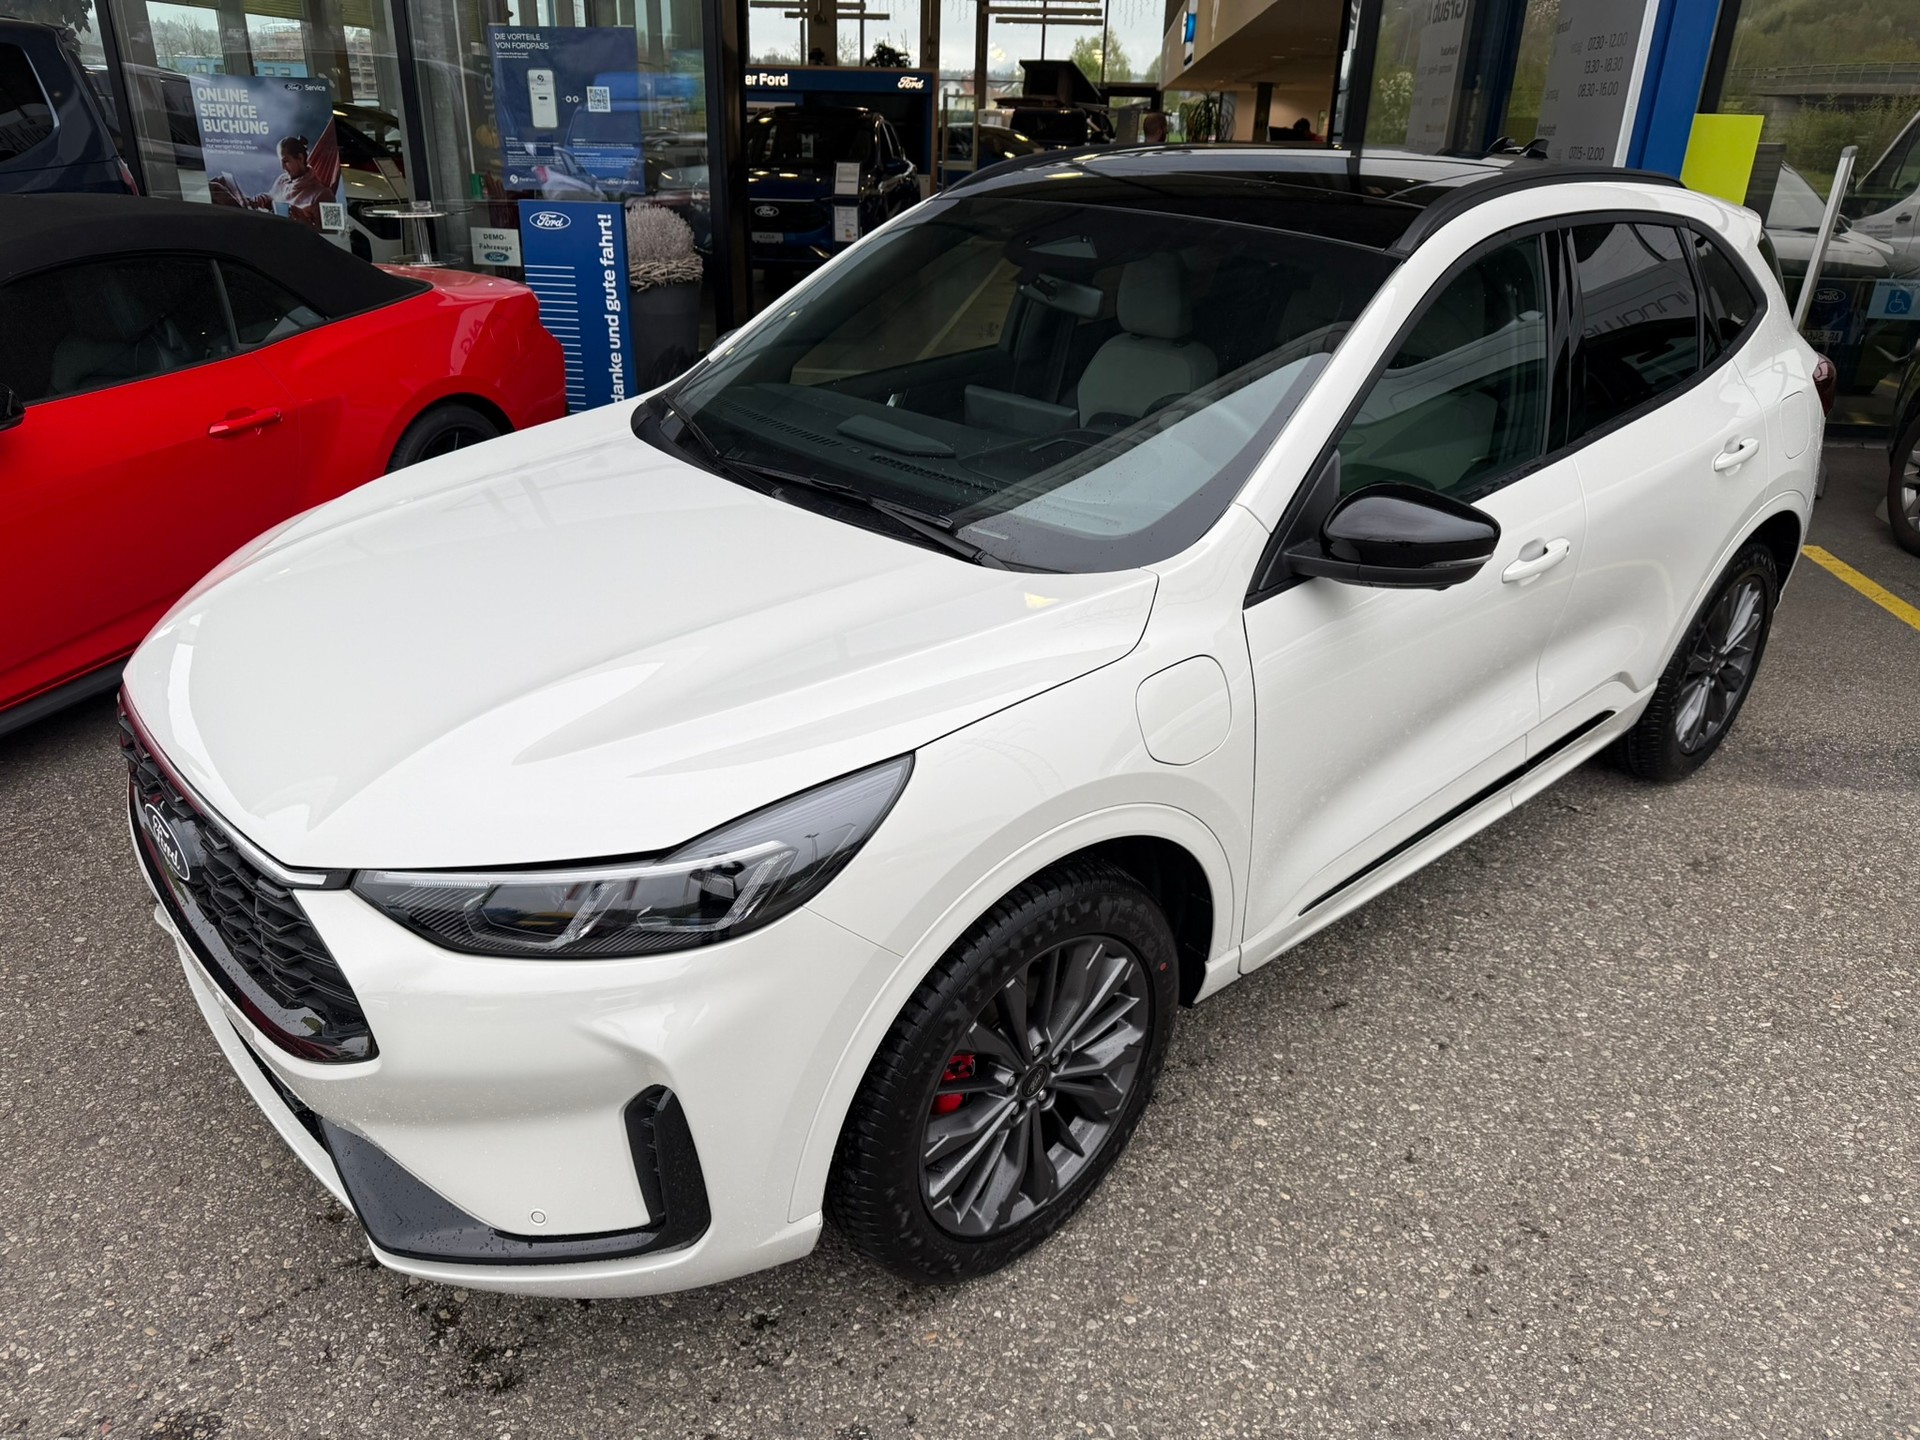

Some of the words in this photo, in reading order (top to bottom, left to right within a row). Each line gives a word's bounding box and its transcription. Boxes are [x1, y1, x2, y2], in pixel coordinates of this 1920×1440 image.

[494, 33, 506, 41] DIE
[506, 33, 541, 41] VORTEILE
[495, 41, 511, 49] VON
[511, 42, 550, 50] FORDPASS
[758, 73, 789, 86] Ford
[897, 76, 924, 89] Ford
[196, 88, 249, 103] ONLINE
[304, 84, 326, 92] Service
[200, 104, 258, 119] SERVICE
[202, 119, 270, 135] BUCHUNG
[537, 212, 565, 228] Ford
[479, 243, 513, 252] Fahrzeuge
[597, 214, 615, 267] fahrt!
[488, 253, 506, 261] Ford
[602, 269, 621, 312] gute
[604, 314, 621, 349] und
[608, 352, 625, 403] danke
[151, 813, 182, 872] Ford
